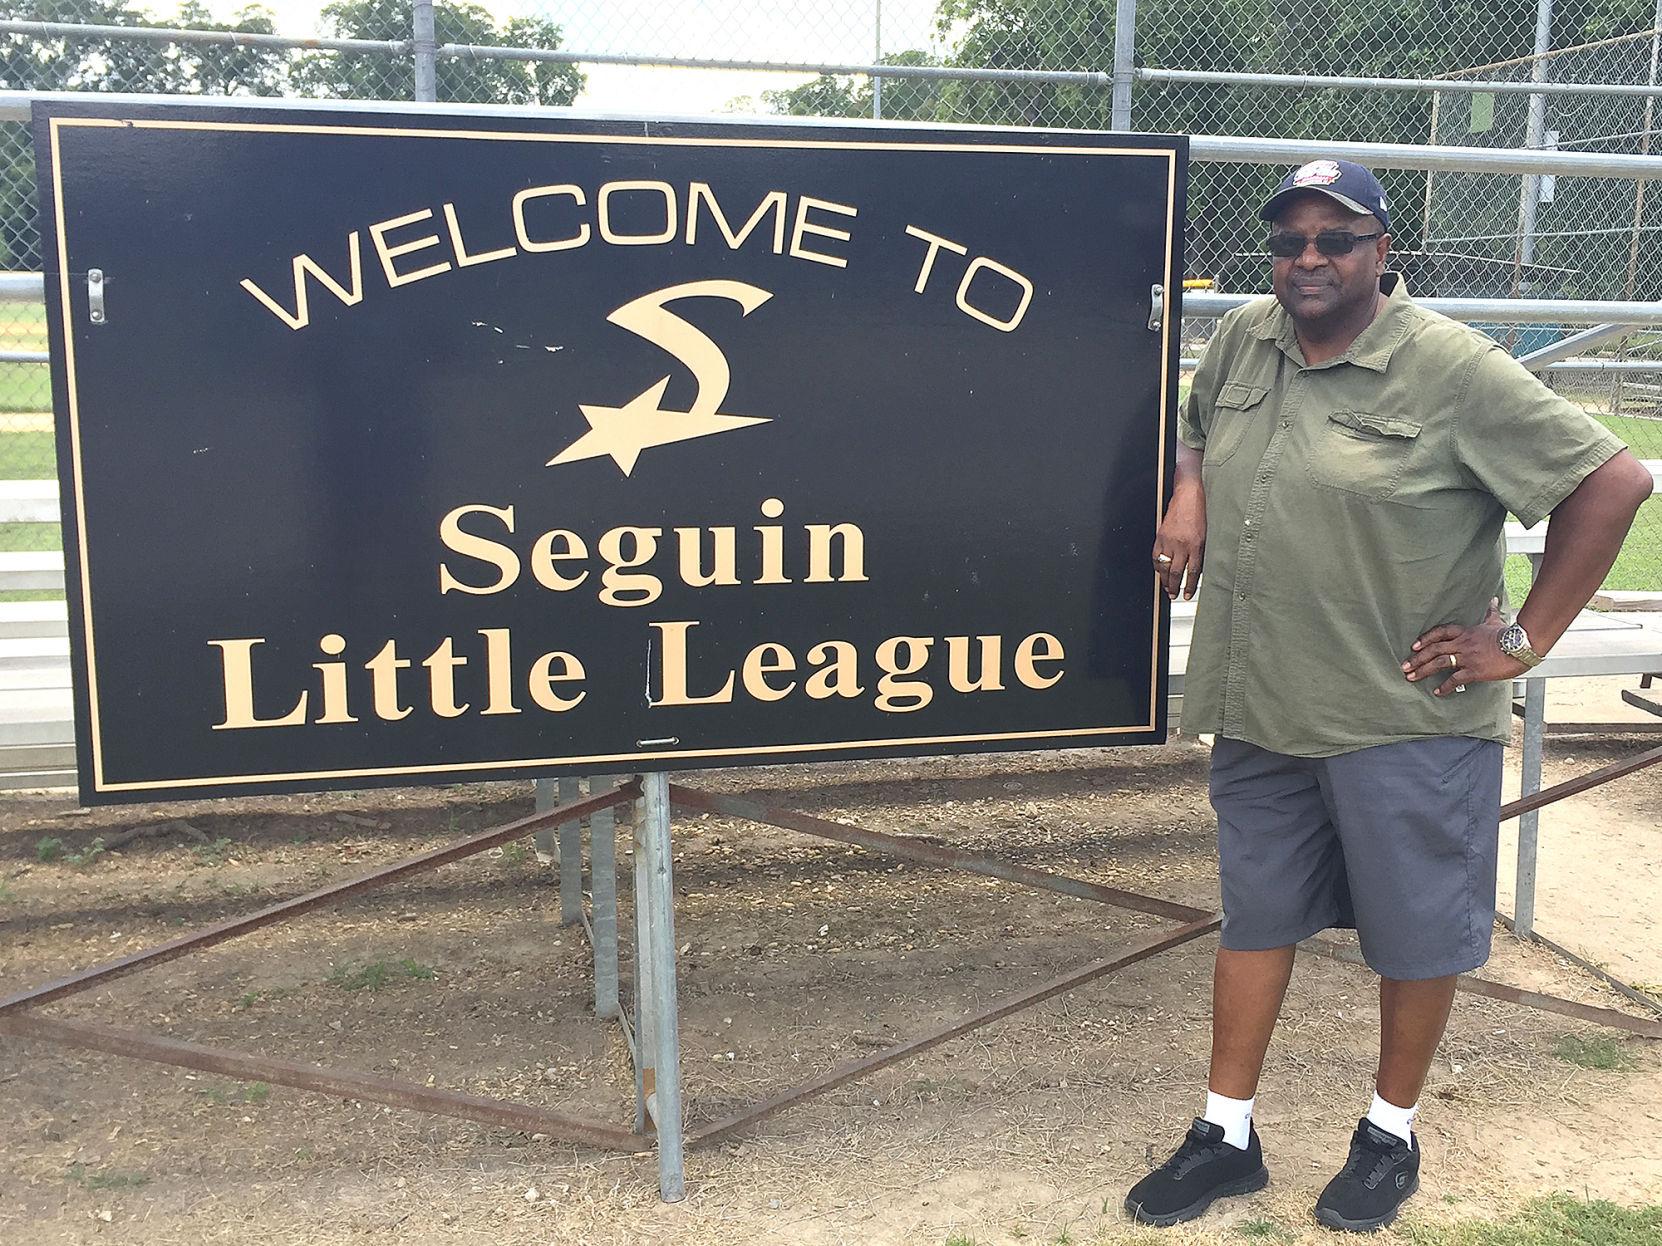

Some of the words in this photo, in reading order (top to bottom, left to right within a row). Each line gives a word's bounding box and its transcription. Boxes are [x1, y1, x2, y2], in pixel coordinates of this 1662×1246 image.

[240, 180, 858, 331] WELCOME
[903, 224, 1035, 333] TO
[438, 498, 870, 608] Seguin
[208, 627, 588, 732] Little
[646, 620, 1066, 714] League
